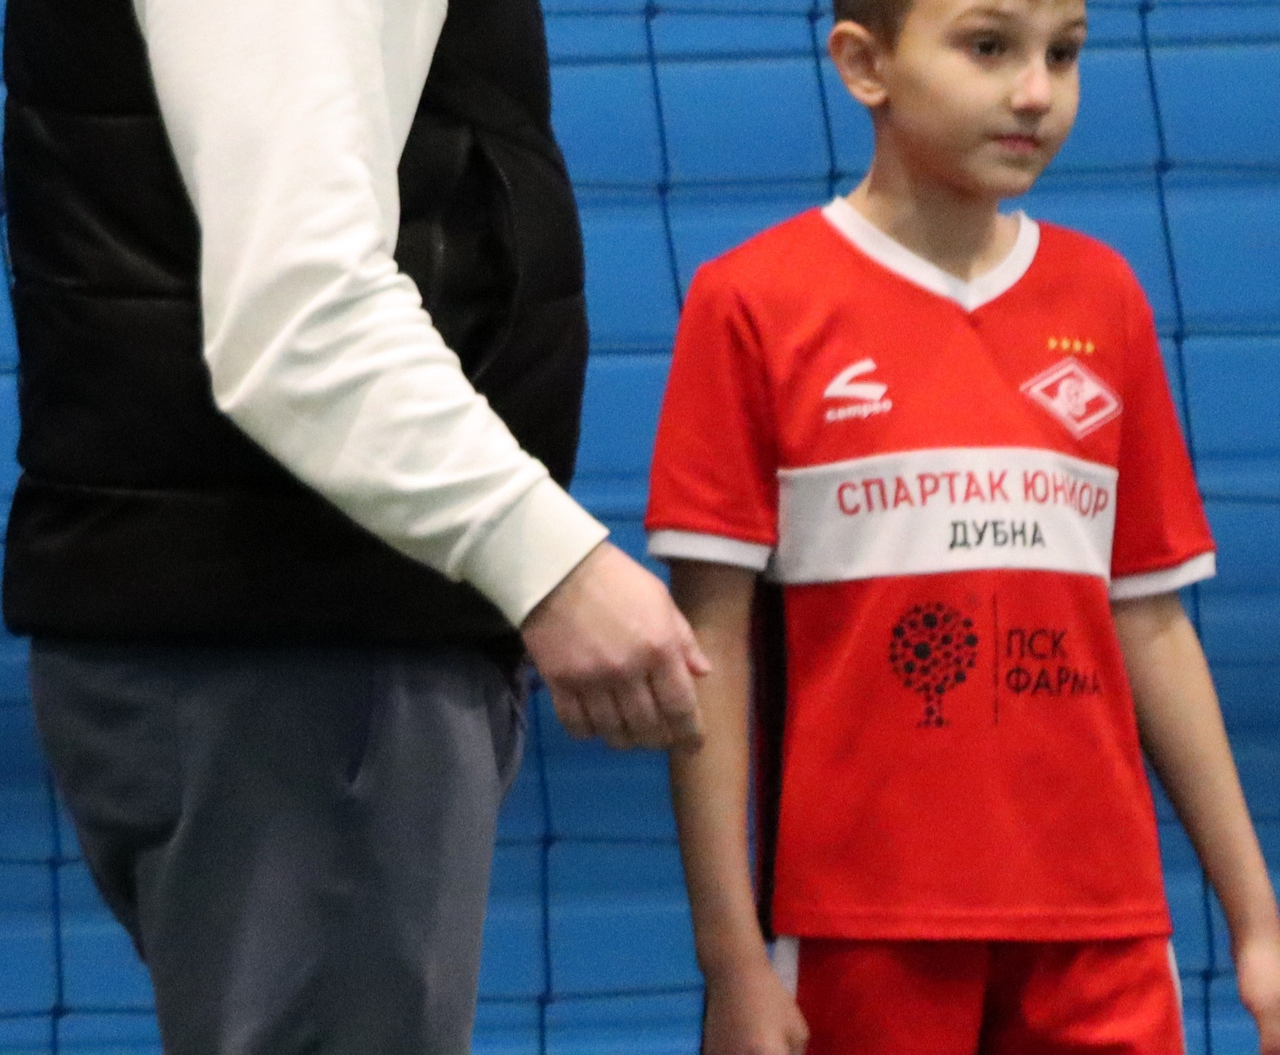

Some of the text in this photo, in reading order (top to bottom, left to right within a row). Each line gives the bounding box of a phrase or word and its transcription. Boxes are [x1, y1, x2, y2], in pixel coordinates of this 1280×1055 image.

[836, 469, 1009, 516] СПАРТАК
[949, 520, 1046, 550] ДУБНА
[1007, 628, 1068, 660] ПСК
